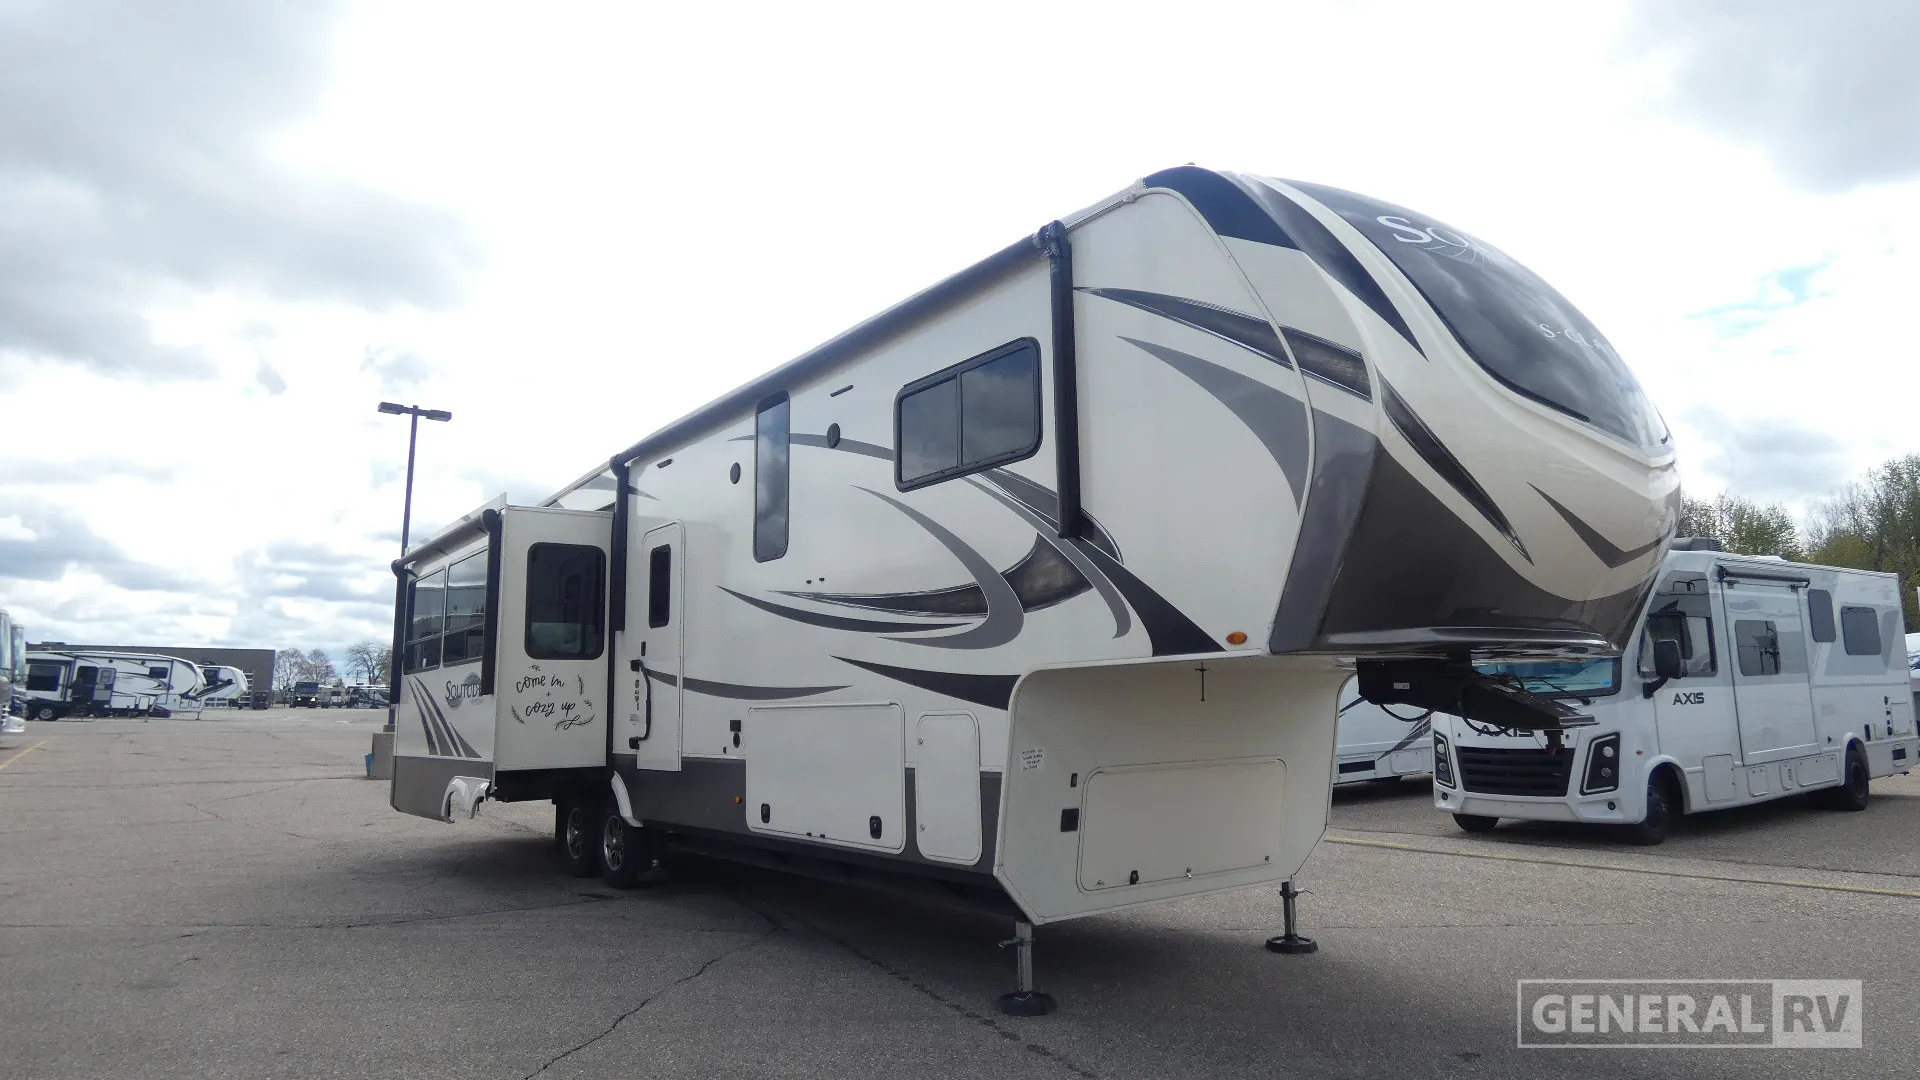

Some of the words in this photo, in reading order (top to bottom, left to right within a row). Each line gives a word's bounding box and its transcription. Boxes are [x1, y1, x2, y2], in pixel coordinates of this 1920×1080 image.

[516, 675, 546, 693] come
[550, 674, 565, 688] in
[1672, 692, 1705, 705] AXIS
[525, 701, 555, 718] cozy
[561, 702, 576, 717] up
